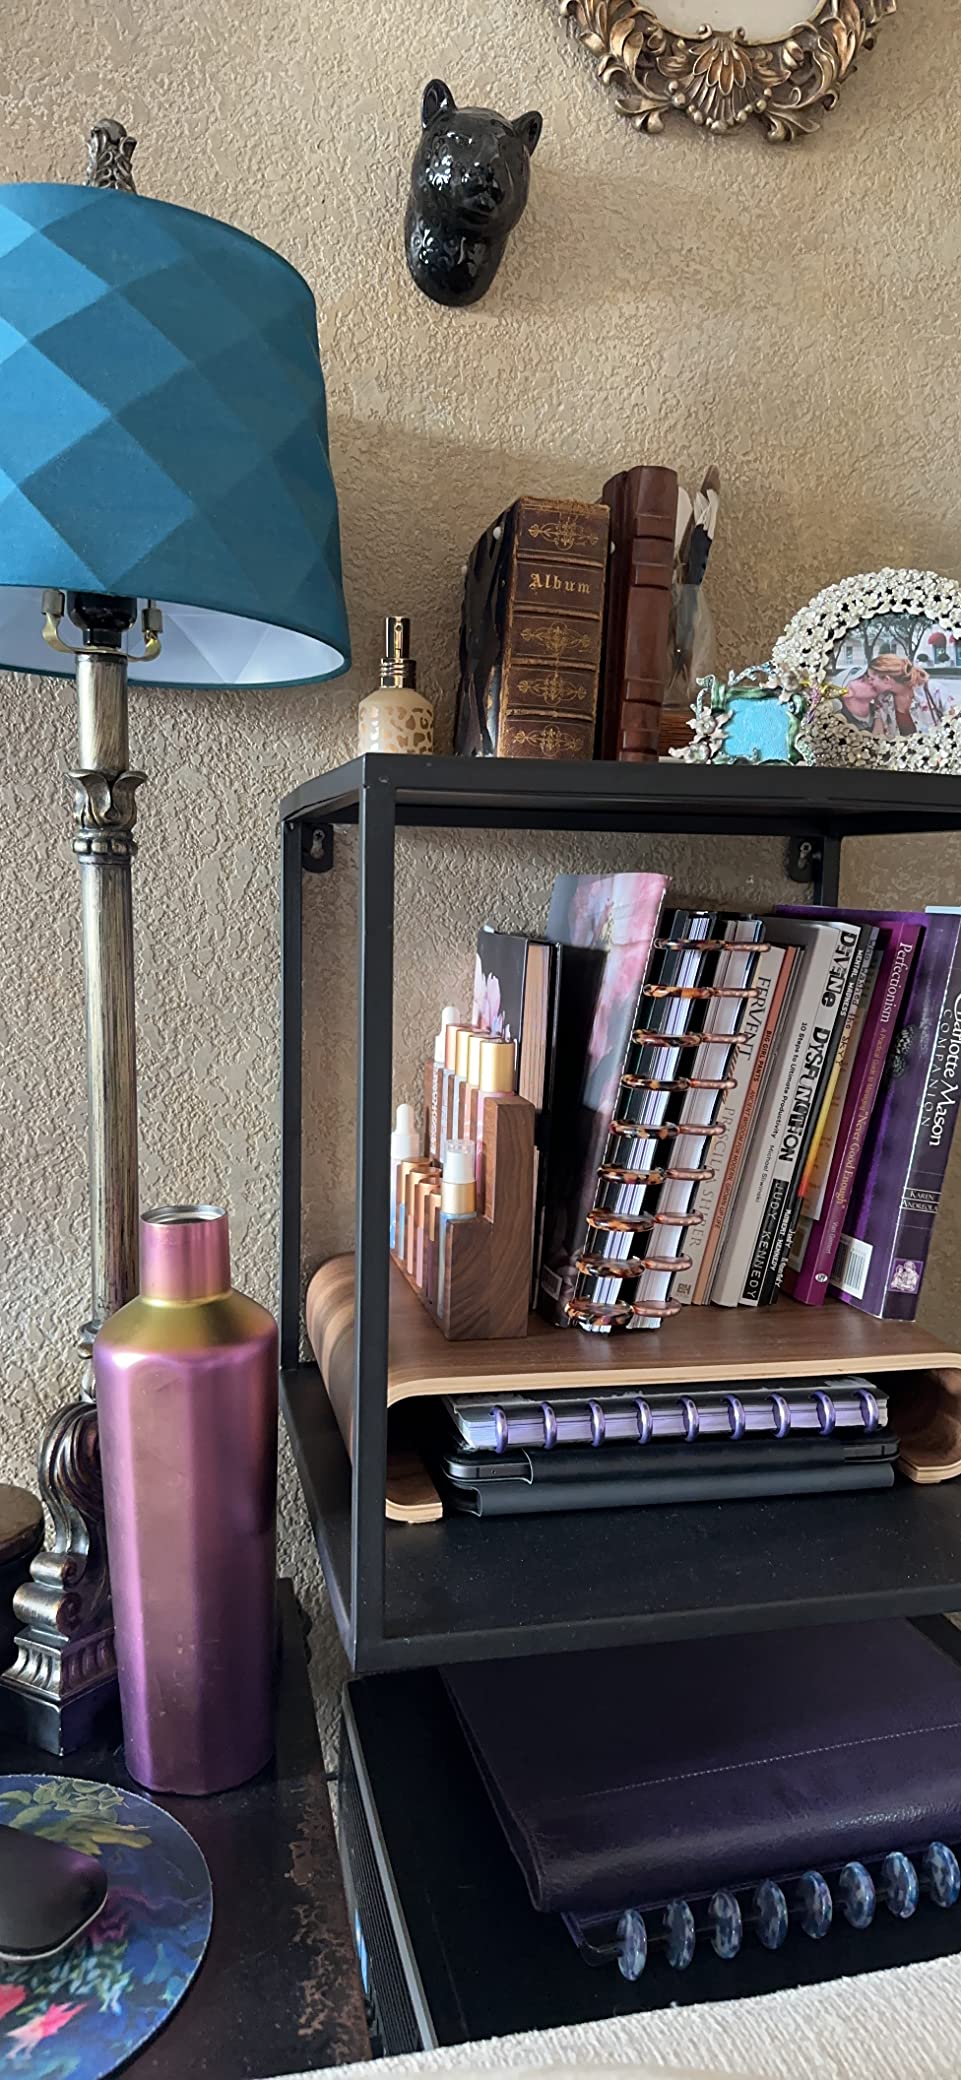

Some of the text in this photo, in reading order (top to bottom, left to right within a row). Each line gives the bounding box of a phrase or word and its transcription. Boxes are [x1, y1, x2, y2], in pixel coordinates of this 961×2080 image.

[529, 573, 591, 594] Album
[840, 950, 863, 1016] MENTAL MADNESS
[880, 942, 913, 1023] Perfectionism
[737, 976, 771, 1060] FERVENT
[800, 1022, 807, 1031] 10
[760, 1043, 768, 1059] GIRL
[794, 1033, 804, 1053] Steps
[754, 1061, 763, 1081] PANTS
[784, 1063, 795, 1094] Ultimate
[921, 1009, 952, 1127] COMPANION
[771, 1095, 788, 1137] Productivity
[929, 1080, 958, 1146] Mason
[846, 1143, 860, 1168] Good
[836, 1170, 853, 1208] Enough"
[910, 1191, 934, 1200] KAREN
[747, 1184, 784, 1298] JUDY KENNEDY
